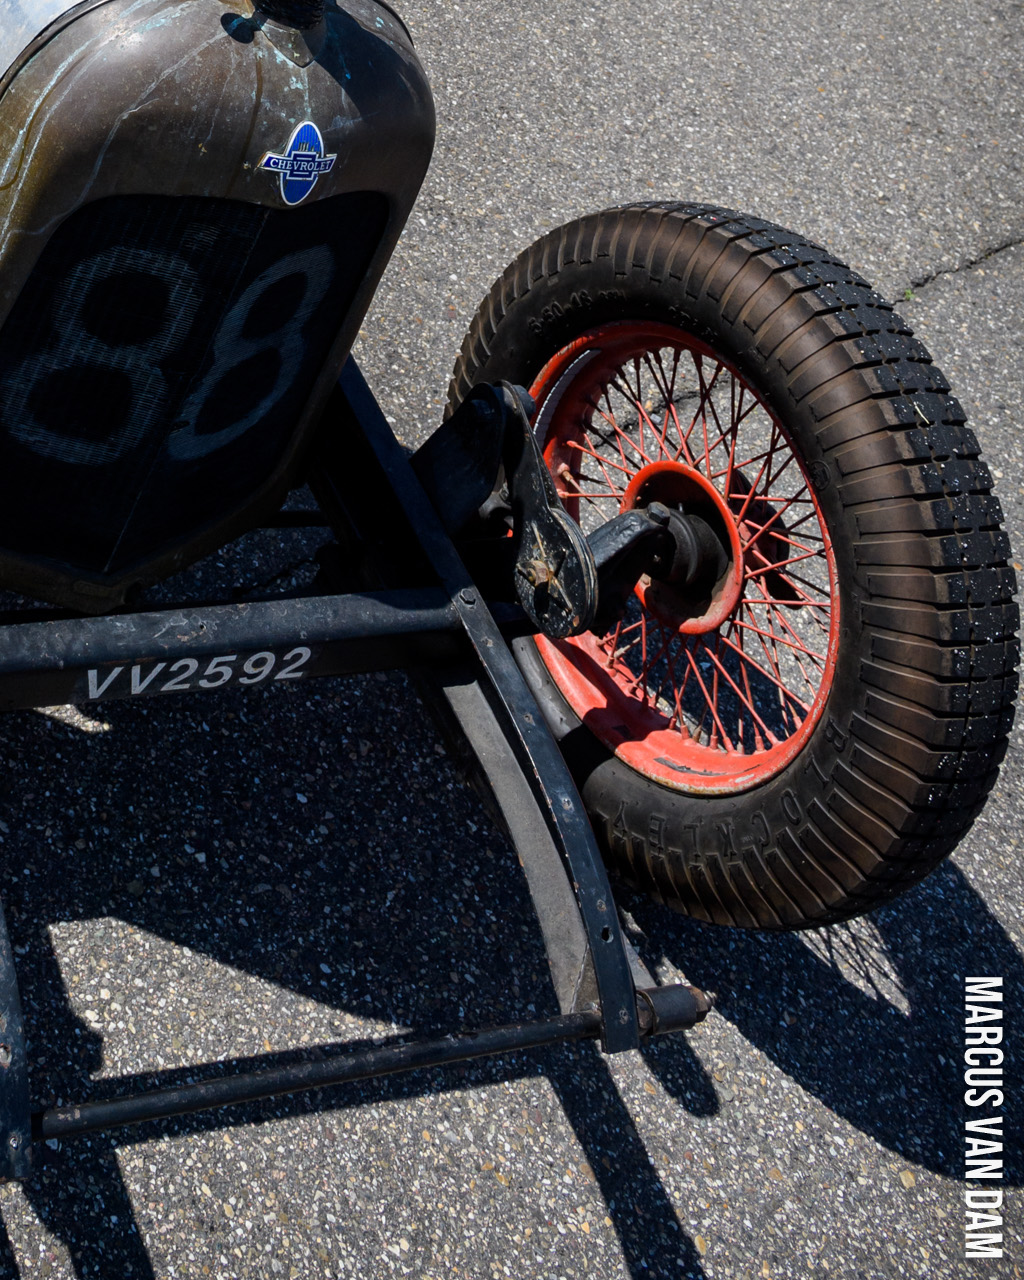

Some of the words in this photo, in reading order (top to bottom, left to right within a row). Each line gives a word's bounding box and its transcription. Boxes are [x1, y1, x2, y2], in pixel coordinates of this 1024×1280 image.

[270, 158, 331, 171] CHEVROLET
[87, 646, 312, 700] VV2592
[612, 716, 848, 858] BLOCKLEY
